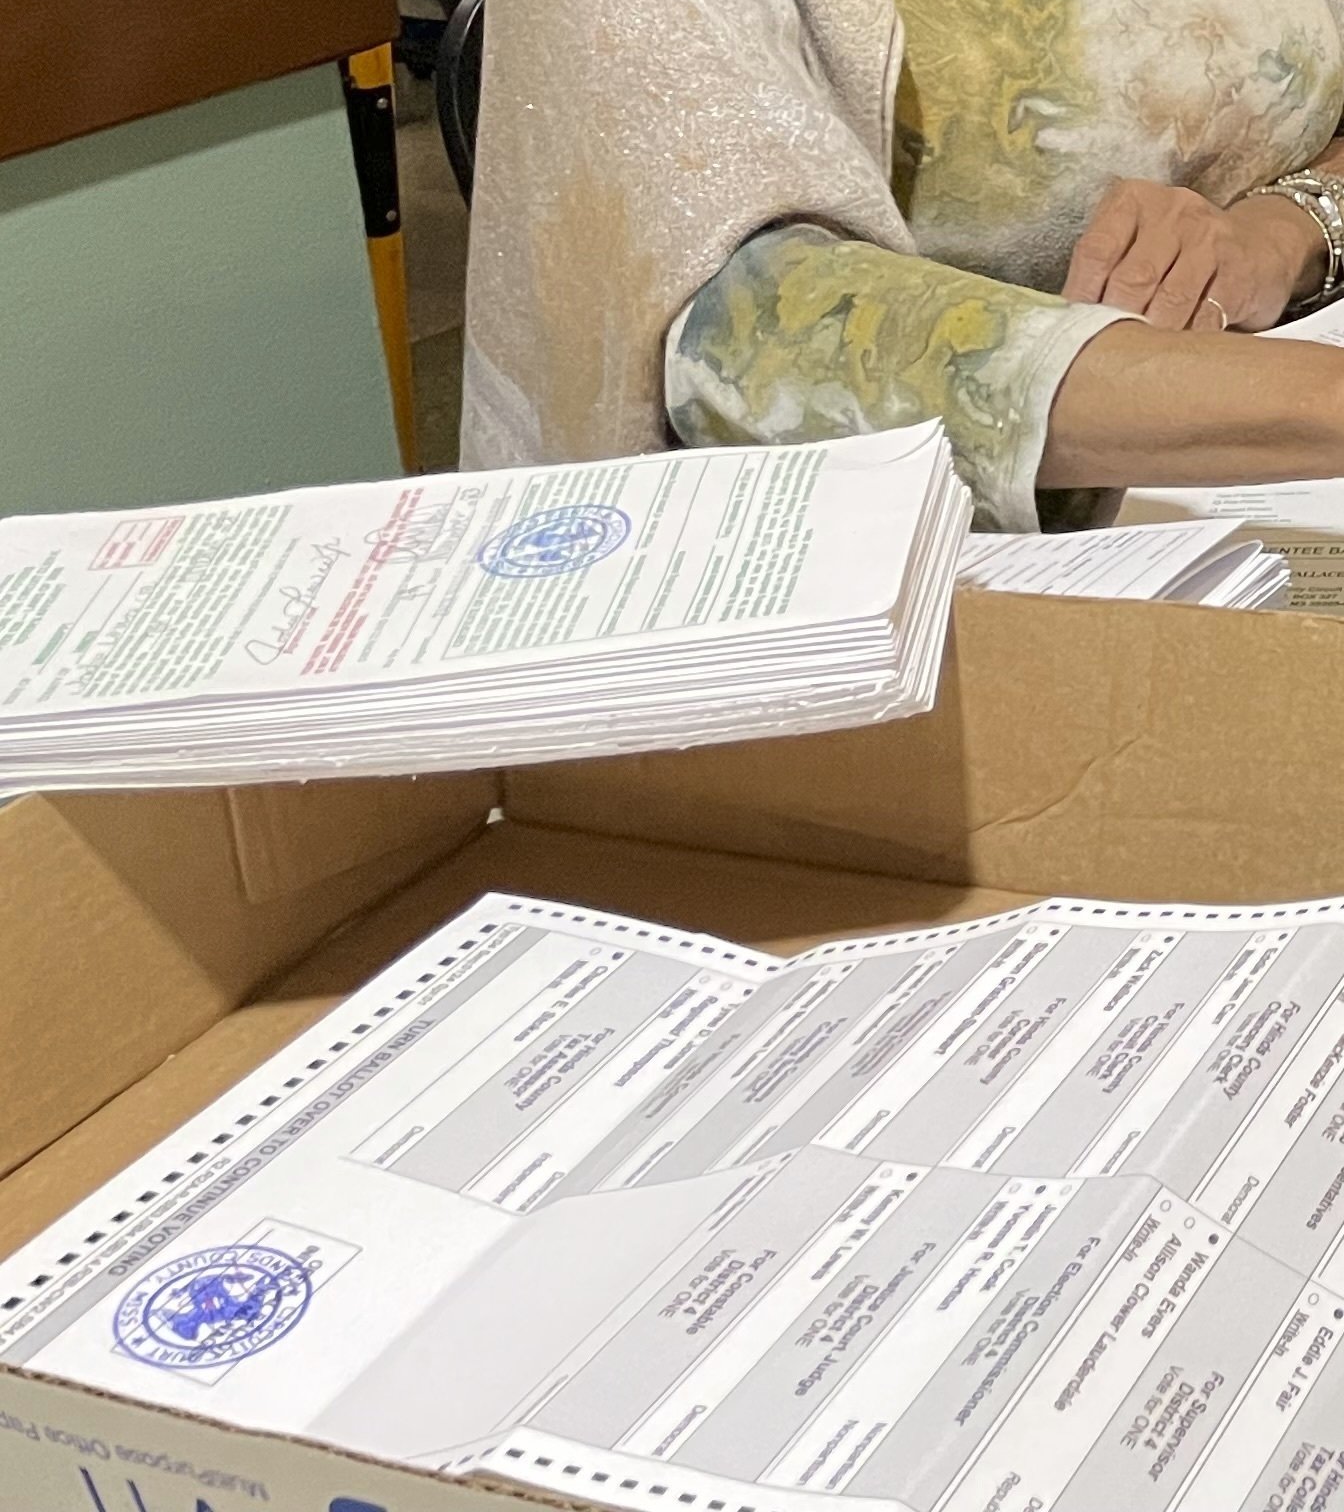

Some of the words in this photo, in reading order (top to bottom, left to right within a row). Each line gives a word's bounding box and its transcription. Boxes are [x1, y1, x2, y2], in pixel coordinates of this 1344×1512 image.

[388, 1019, 436, 1051] TURN
[328, 1052, 392, 1099] BALLOT
[283, 1101, 330, 1137] OVER
[260, 1139, 282, 1156] TO
[176, 1157, 263, 1223] CONTINUE
[108, 1224, 179, 1276] VOTING
[1142, 1232, 1180, 1281] Allison
[1168, 1251, 1208, 1297] Wanda
[1109, 1282, 1149, 1333] Clower
[1141, 1297, 1176, 1338] Evers
[1302, 1325, 1333, 1366] Eddie
[1054, 1331, 1115, 1411] Lauderdale
[1199, 1370, 1224, 1400] For
[1292, 1365, 1308, 1379] J.
[1152, 1381, 1194, 1437] District
[1277, 1382, 1301, 1412] Fair
[1143, 1436, 1158, 1450] 4
[1148, 1398, 1206, 1481] Supervisor
